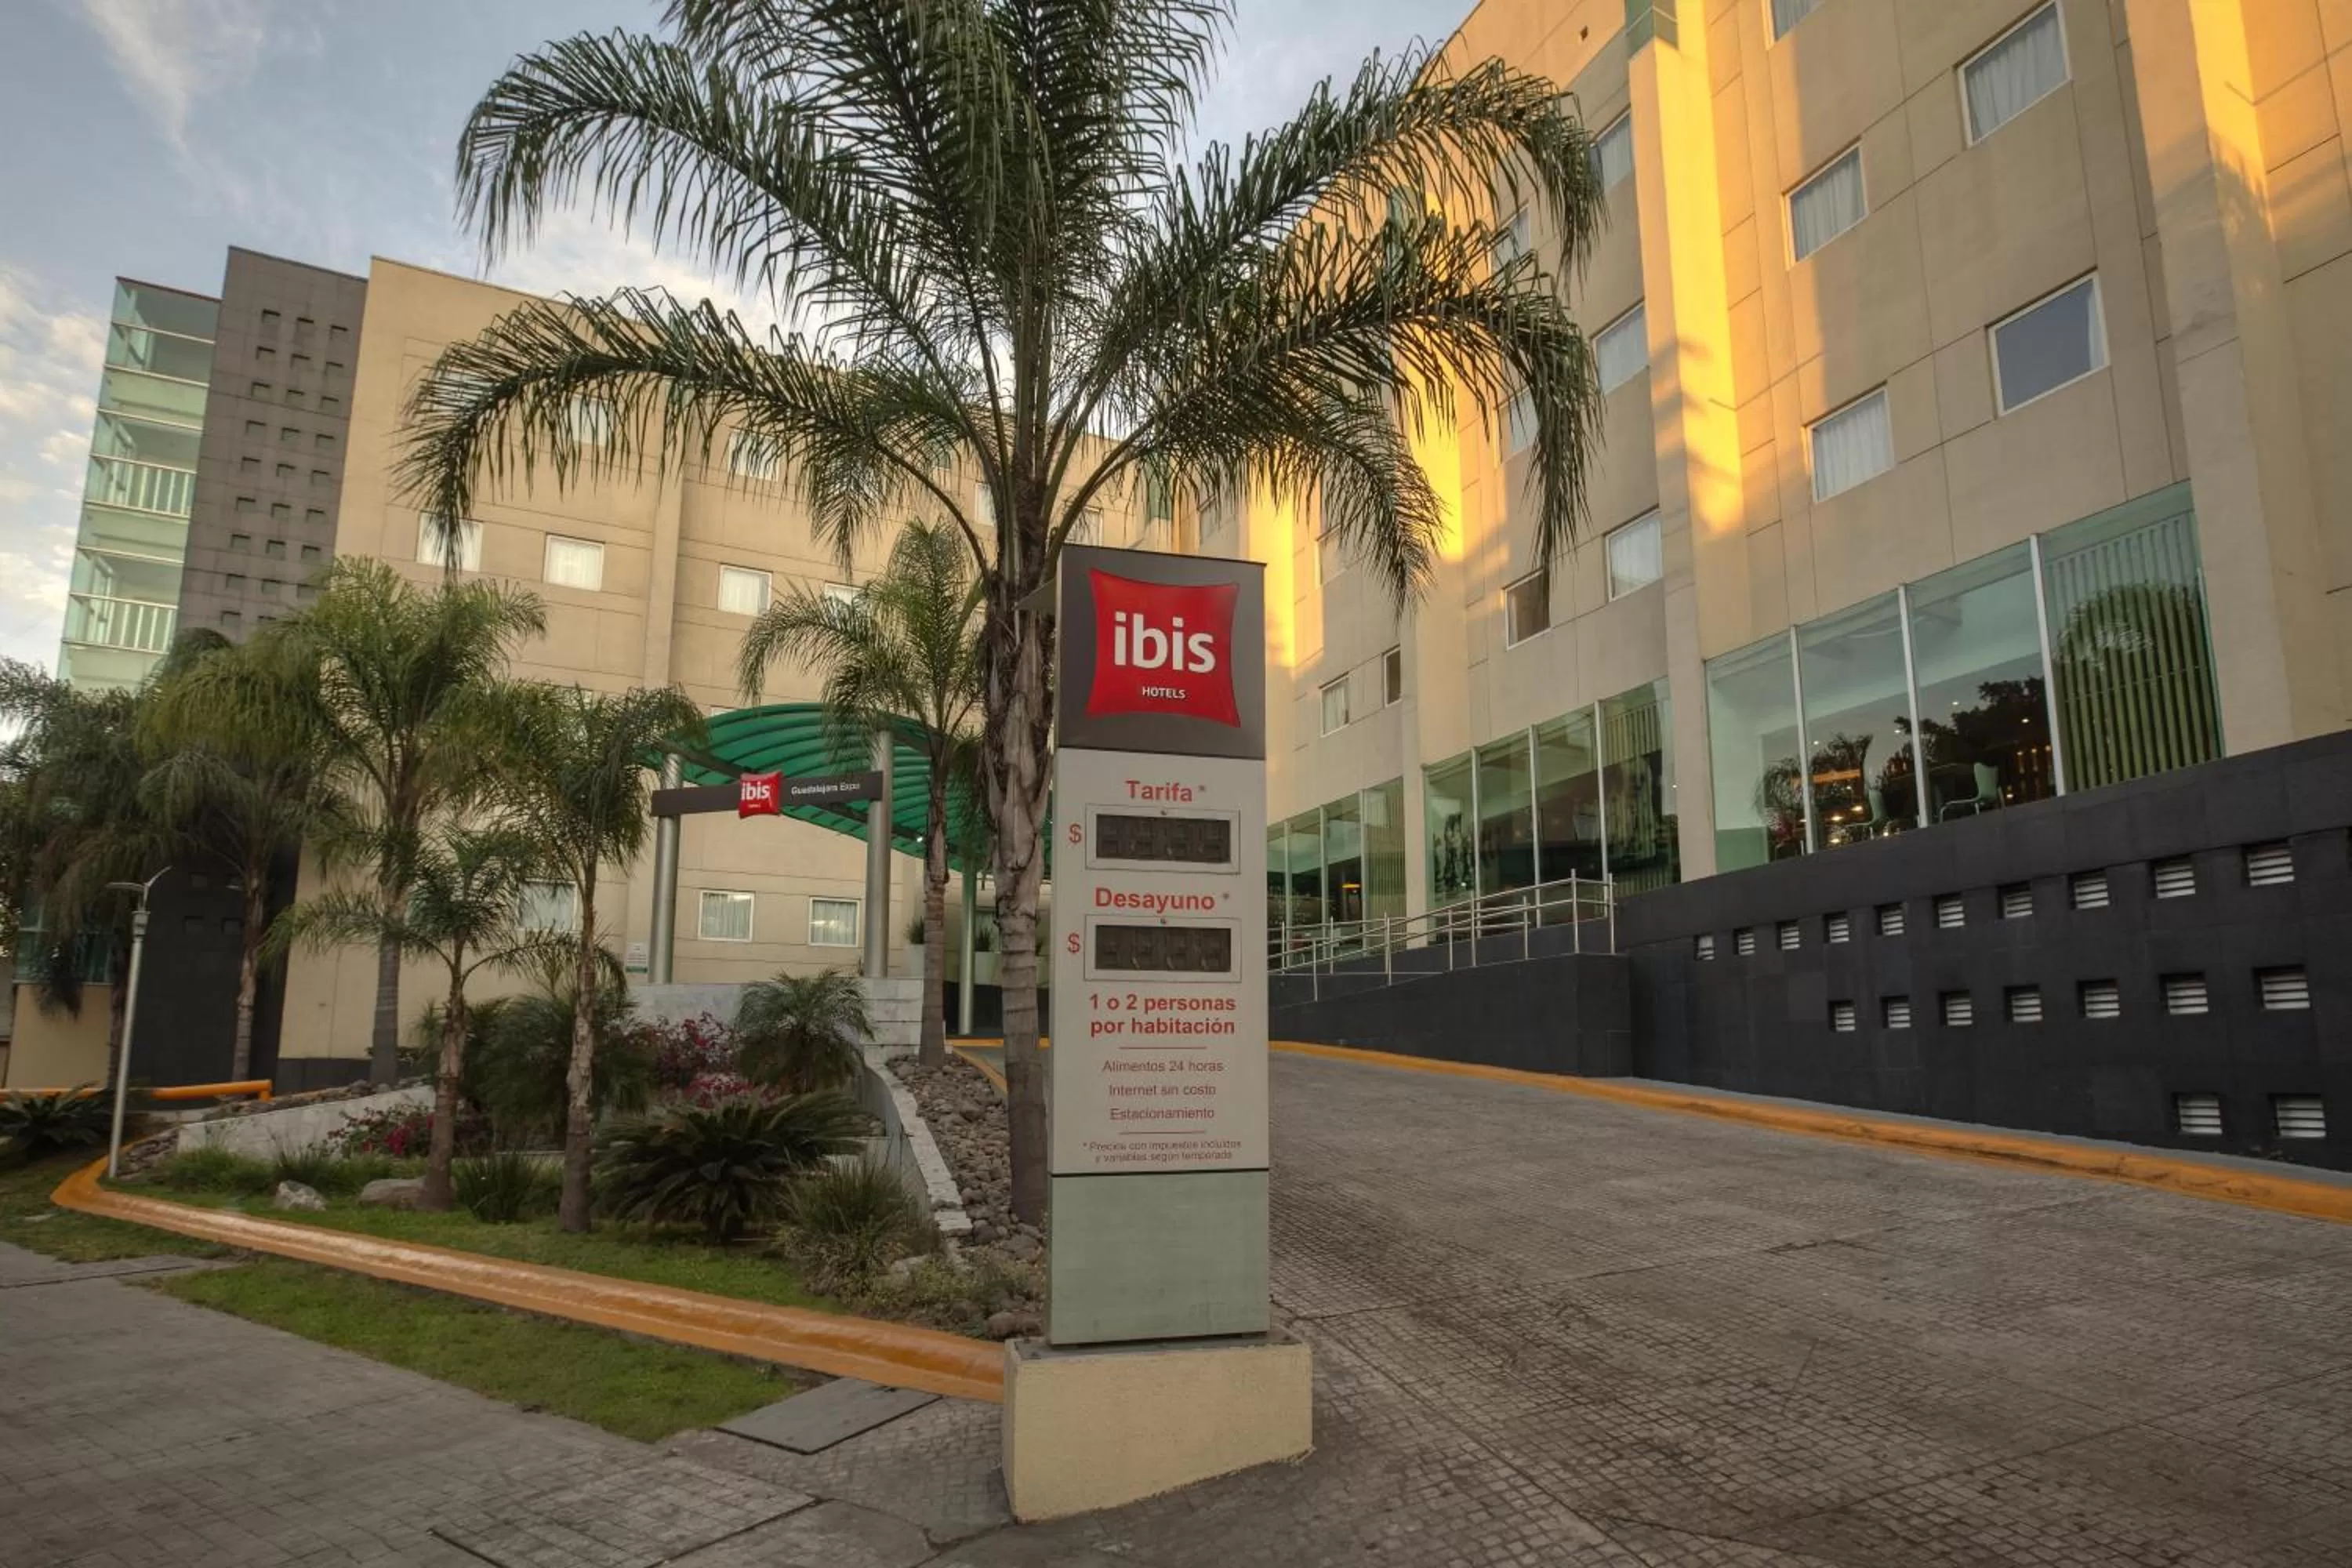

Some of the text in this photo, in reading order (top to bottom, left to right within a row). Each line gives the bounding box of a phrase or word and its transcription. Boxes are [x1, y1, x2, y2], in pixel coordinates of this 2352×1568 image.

[1114, 611, 1216, 673] ibis
[1142, 686, 1186, 699] HOTELS
[741, 781, 770, 800] ibis
[1095, 887, 1215, 913] Desayuno
[1089, 993, 1237, 1014] 1 o 2 personas
[1091, 1018, 1235, 1038] por habitación
[1102, 1060, 1224, 1073] Alimentos 24 horas
[1109, 1084, 1217, 1096] Internet sin costo
[1109, 1107, 1215, 1120] Estacionamiento
